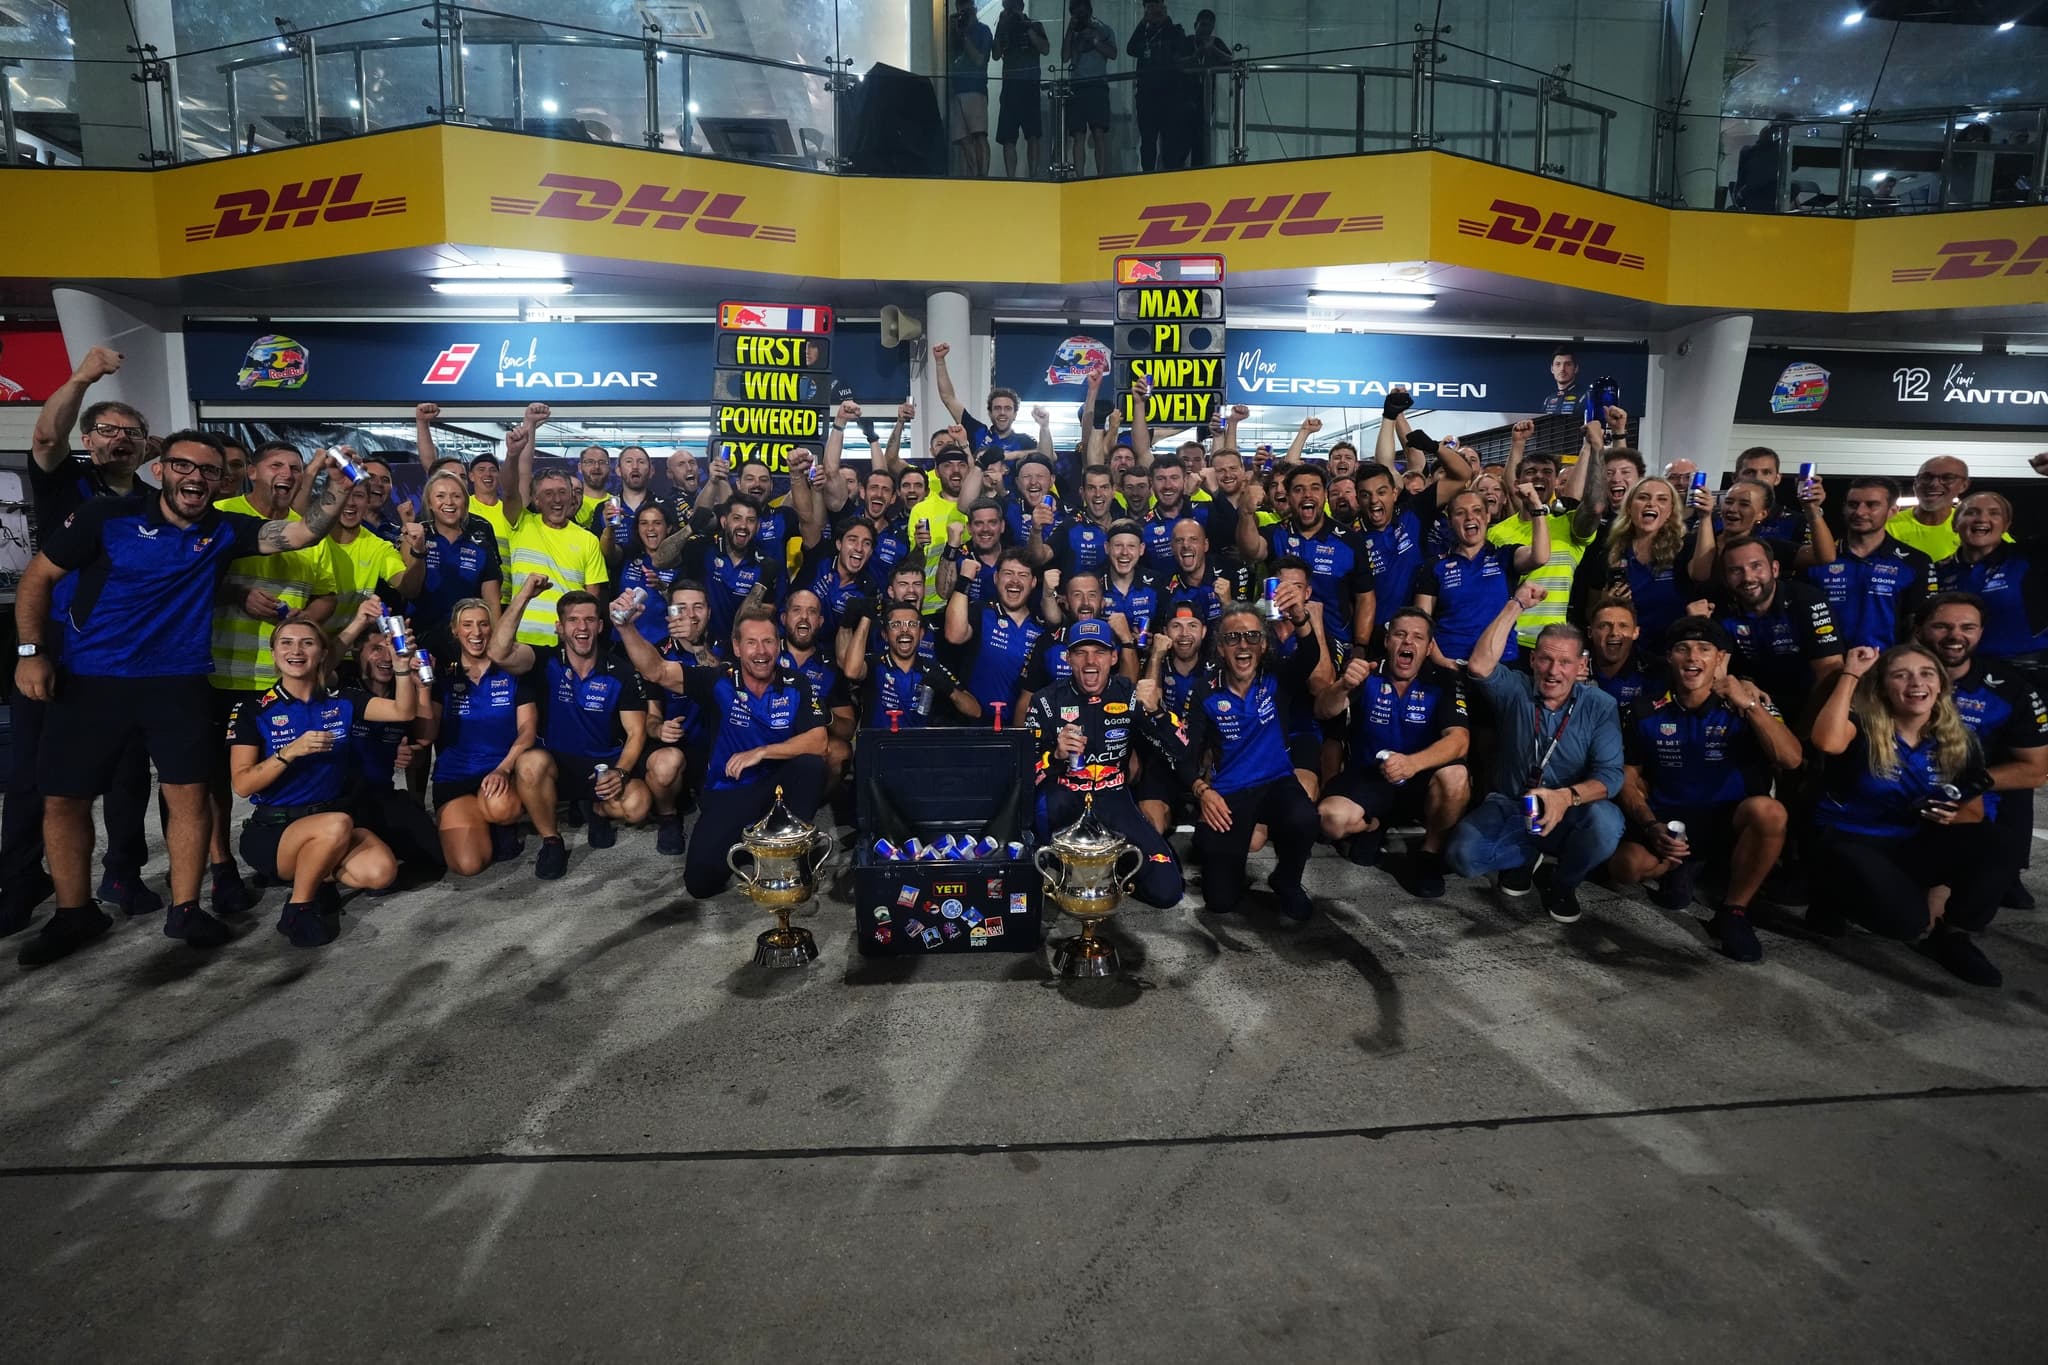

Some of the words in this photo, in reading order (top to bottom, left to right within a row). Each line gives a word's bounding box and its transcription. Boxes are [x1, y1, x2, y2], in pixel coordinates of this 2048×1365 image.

[214, 173, 374, 238] DHL
[535, 173, 758, 238] DHL
[1135, 191, 1342, 247] DHL
[1486, 199, 1623, 264] DHL
[1139, 288, 1200, 318] MAX
[736, 335, 806, 367] FIRST
[1154, 324, 1181, 353] P1
[422, 343, 480, 385] 6
[1131, 359, 1218, 388] SIMPLY
[1237, 348, 1277, 382] Max
[1943, 363, 1975, 391] Kimi
[495, 371, 658, 388] HADJAR
[744, 371, 799, 402] WIN
[1236, 376, 1487, 398] VERSTAPPEN
[1893, 367, 1930, 402] 12
[720, 406, 817, 436] POWERED
[1811, 602, 1828, 611] VISA
[1085, 748, 1127, 764] ACLE
[936, 884, 963, 894] YETI
